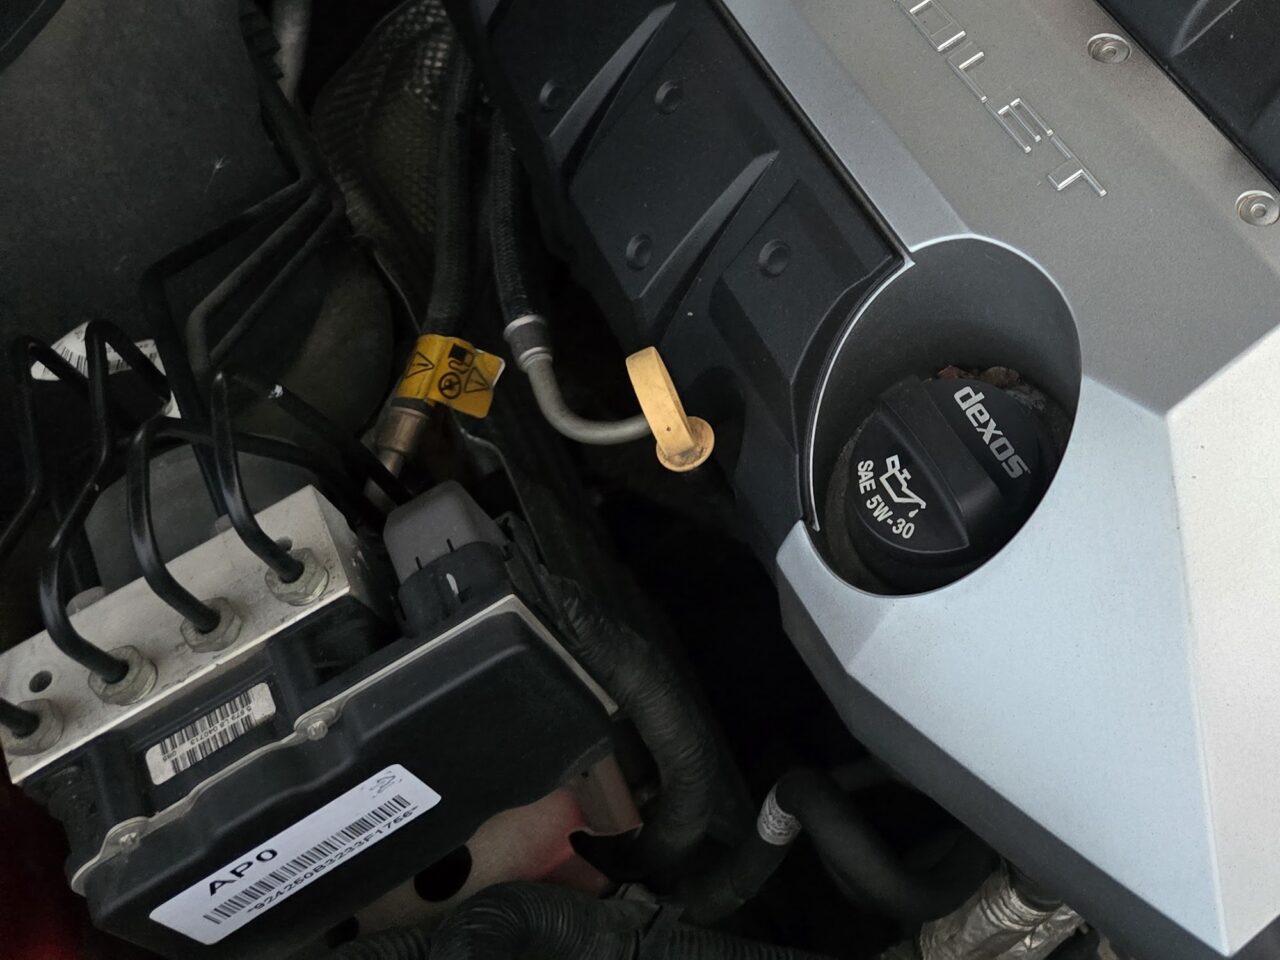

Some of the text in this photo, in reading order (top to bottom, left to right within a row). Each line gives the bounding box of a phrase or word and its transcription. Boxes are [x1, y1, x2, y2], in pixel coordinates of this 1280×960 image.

[953, 386, 1031, 479] dexos
[857, 459, 916, 539] SAE 5W-30
